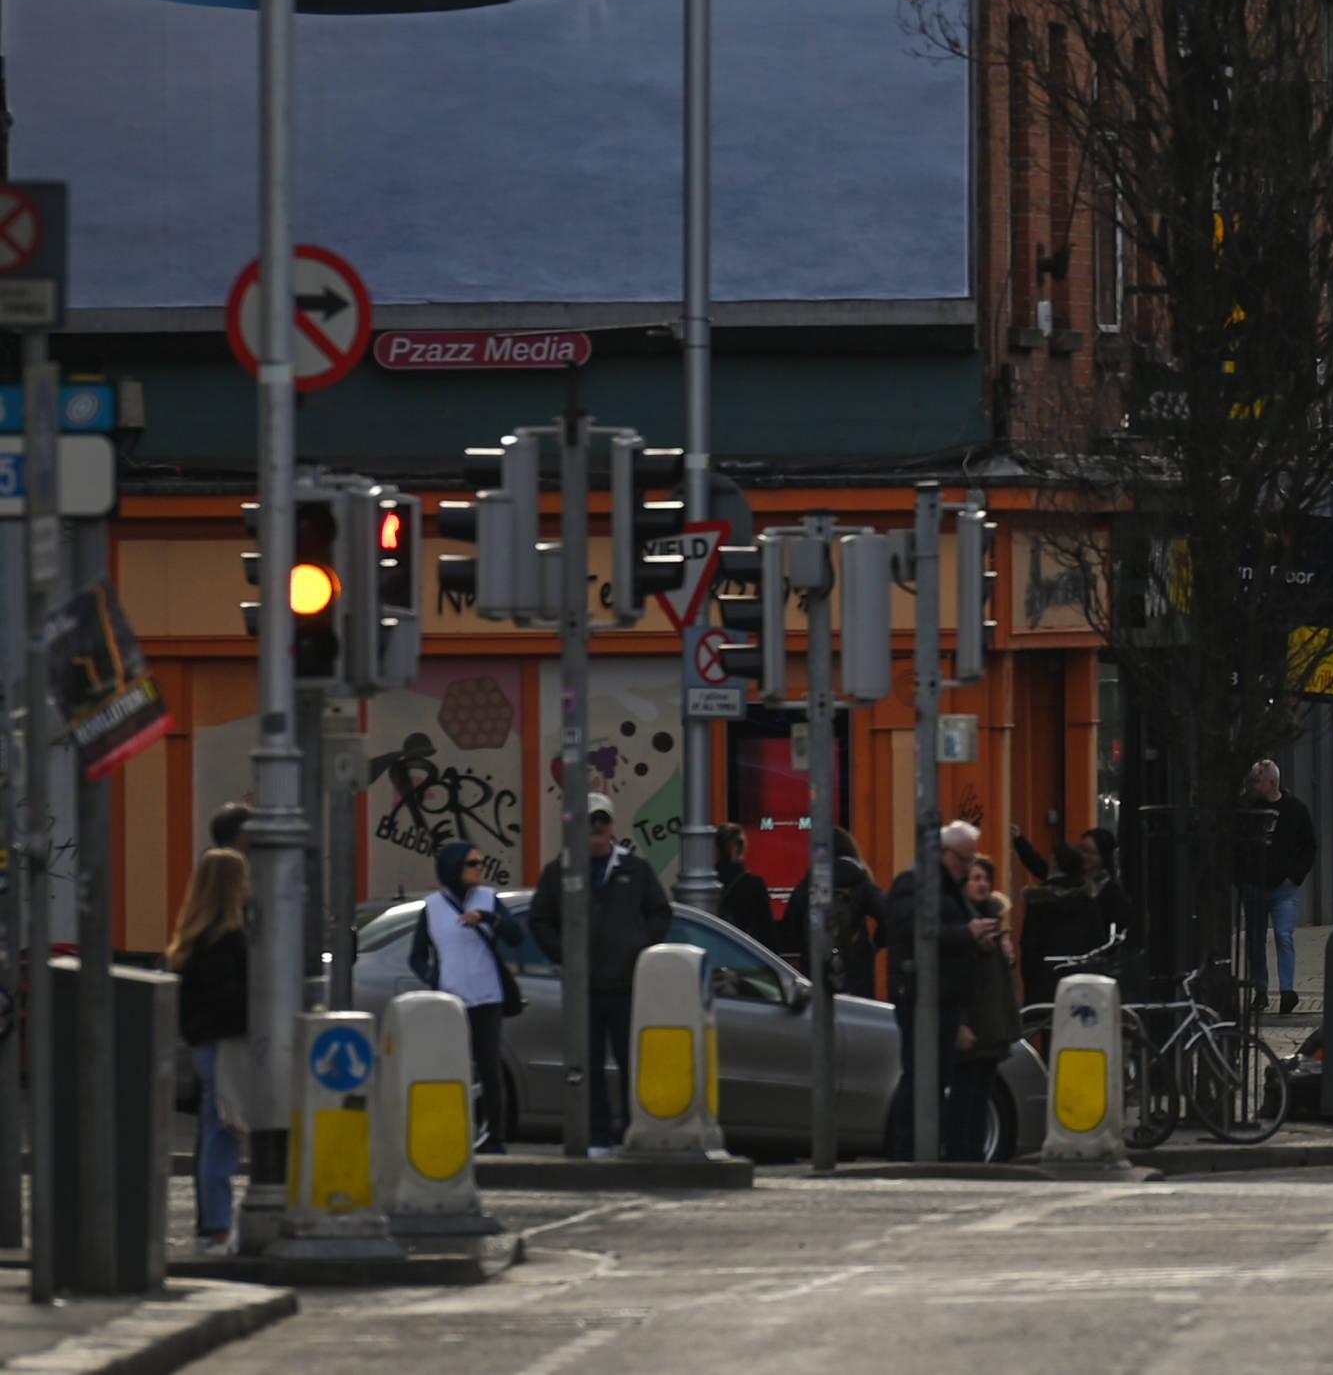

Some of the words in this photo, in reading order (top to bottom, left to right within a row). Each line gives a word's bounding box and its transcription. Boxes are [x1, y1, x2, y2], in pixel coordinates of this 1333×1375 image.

[388, 337, 475, 363] Pzazz
[483, 335, 576, 362] Media
[376, 816, 440, 858] Bubbl
[633, 816, 683, 847] Tea
